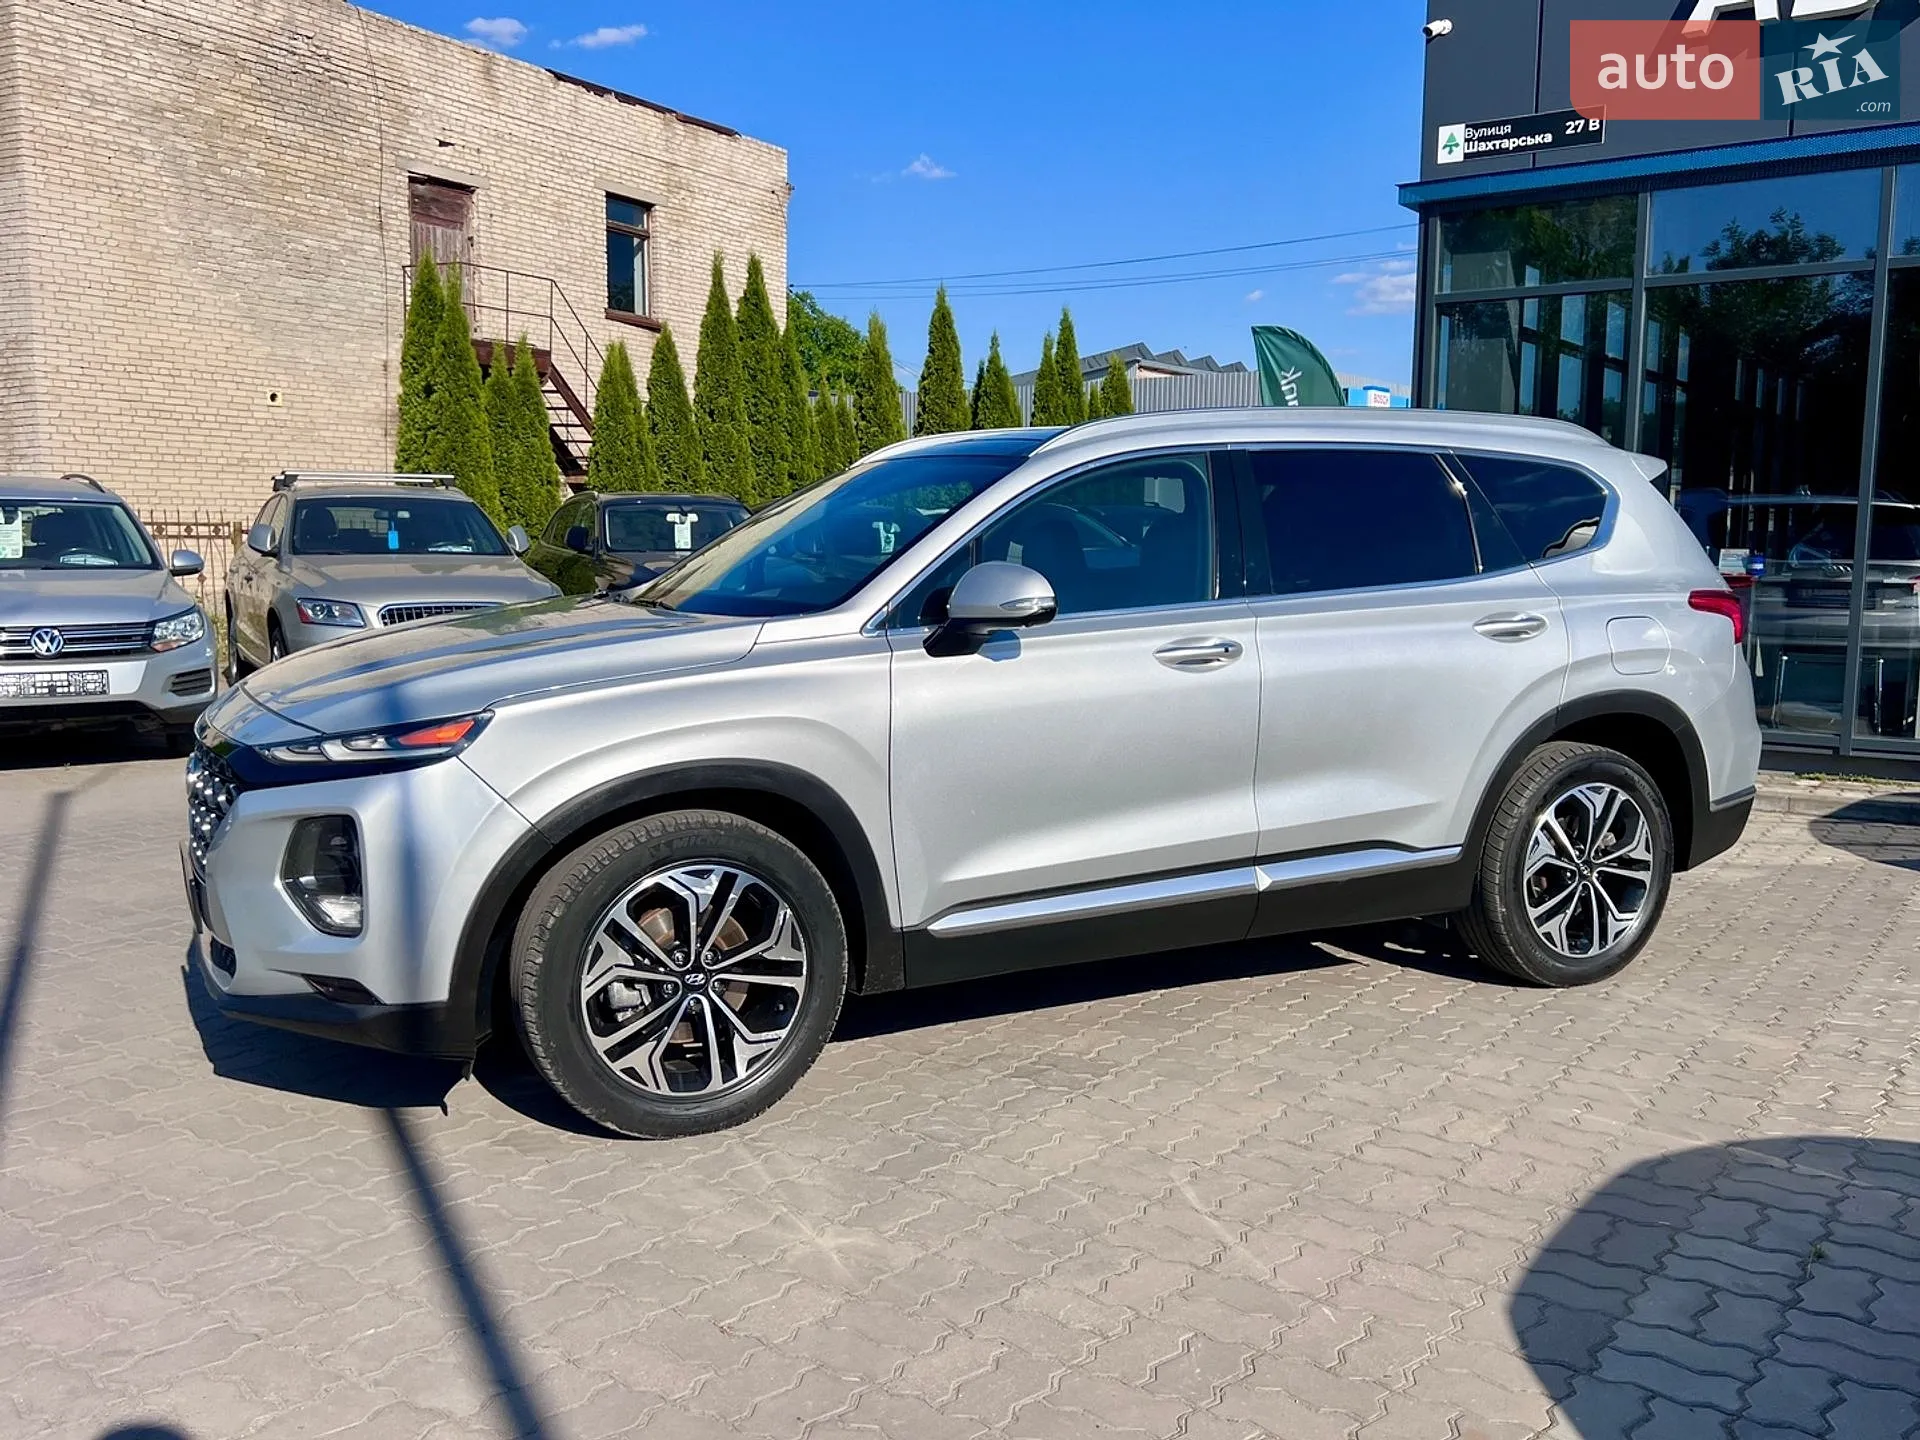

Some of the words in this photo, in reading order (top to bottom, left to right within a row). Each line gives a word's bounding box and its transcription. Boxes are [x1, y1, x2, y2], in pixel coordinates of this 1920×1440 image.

[1465, 125, 1512, 138] Вулиця
[1565, 120, 1584, 135] 27
[1464, 132, 1553, 153] Шахтарська
